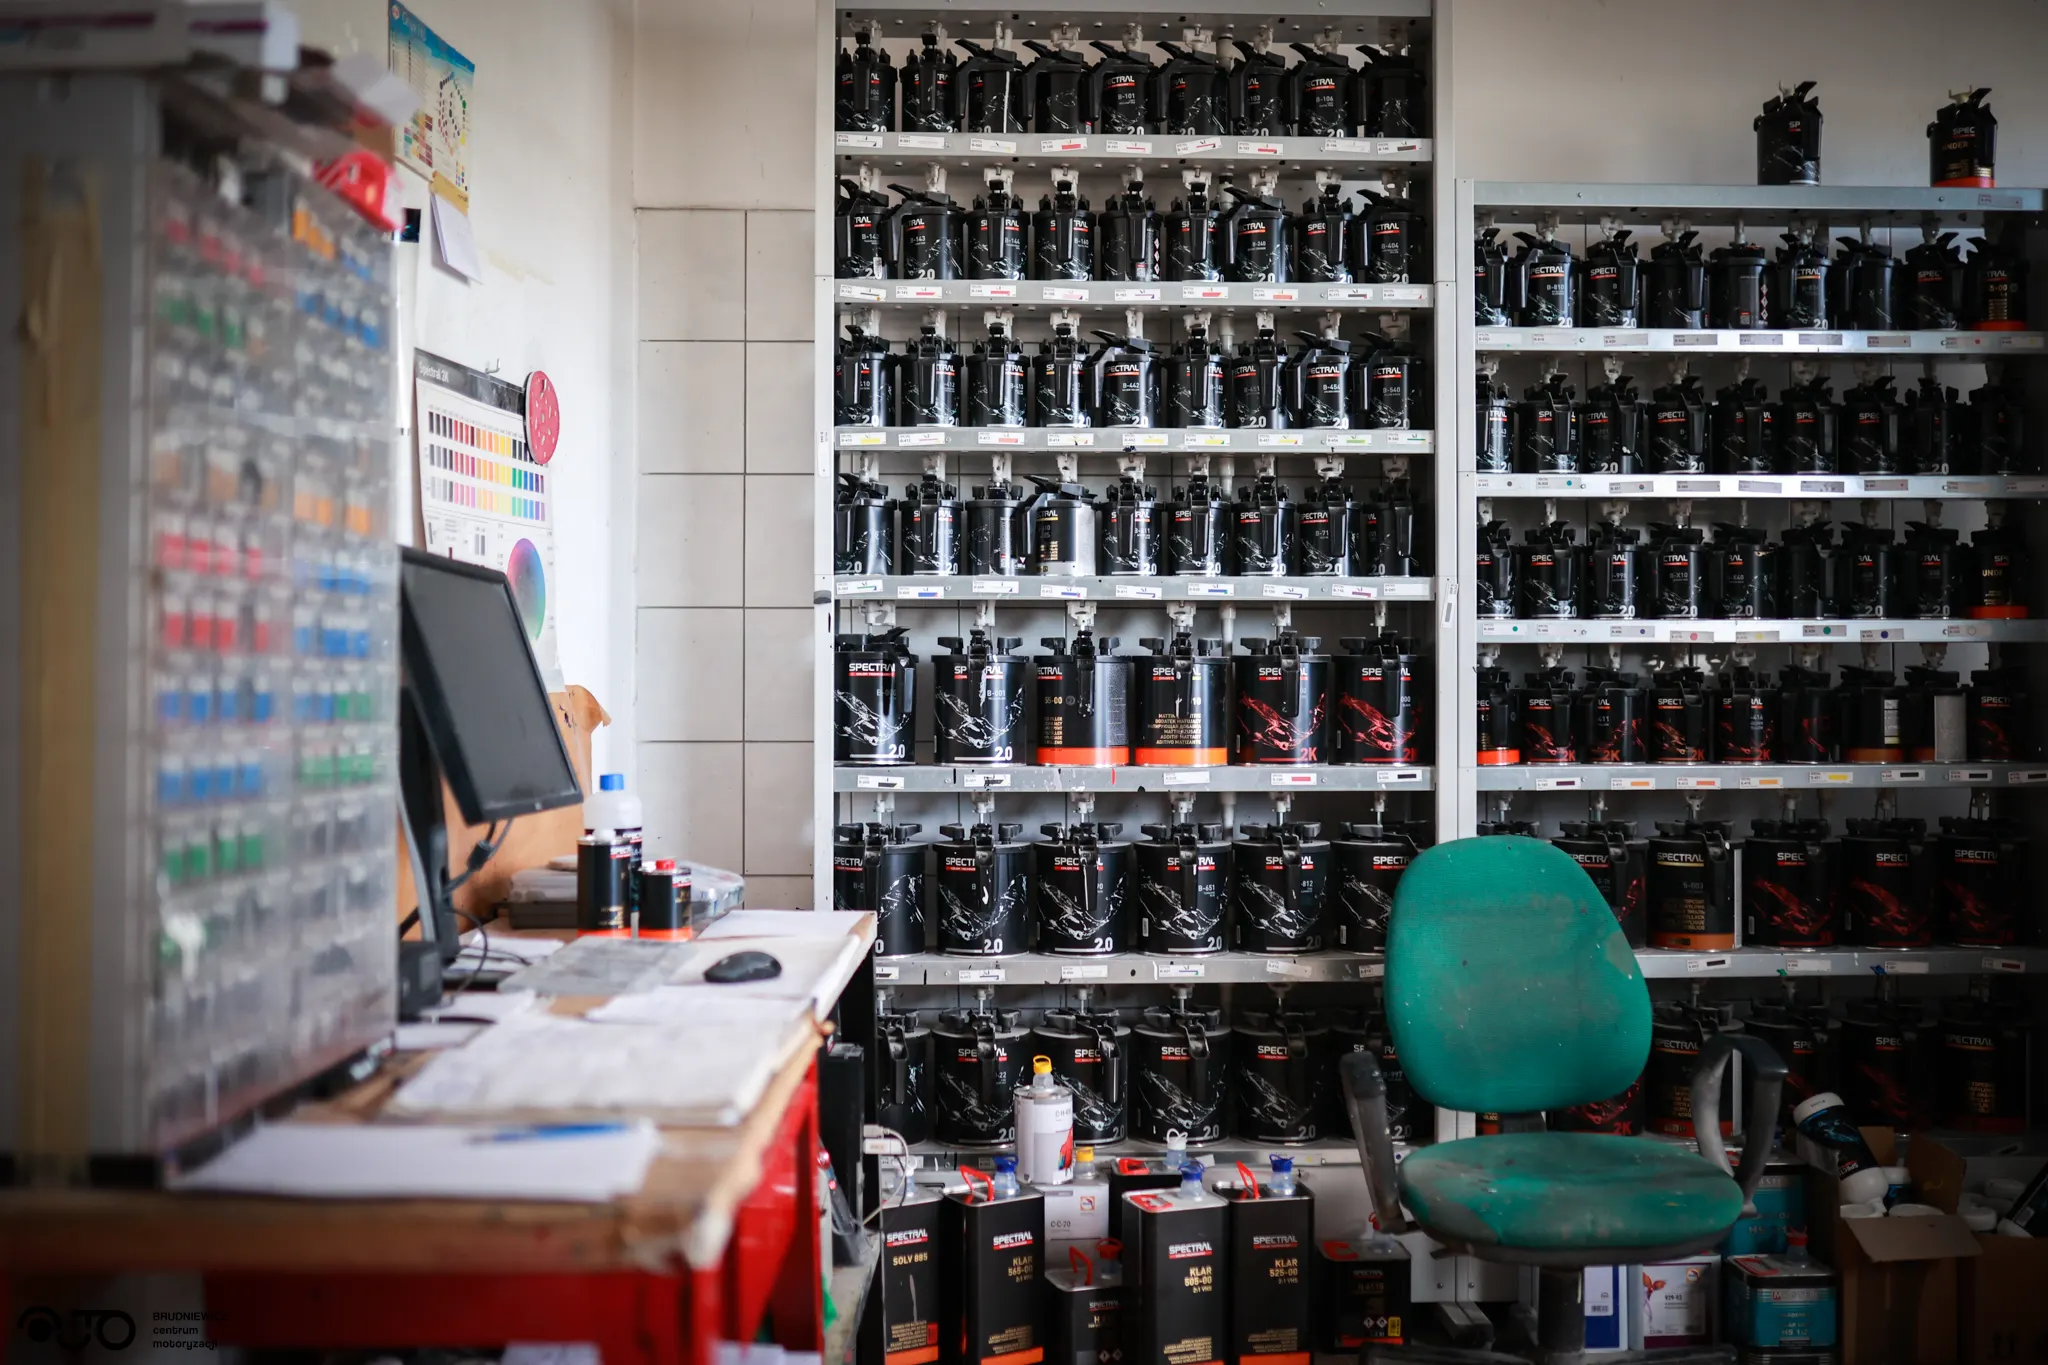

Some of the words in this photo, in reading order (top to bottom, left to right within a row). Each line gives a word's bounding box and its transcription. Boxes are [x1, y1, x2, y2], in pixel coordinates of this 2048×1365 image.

[888, 745, 906, 759] 2.0
[994, 746, 1013, 761] 2.0
[983, 939, 1004, 954] 2.0
[1093, 937, 1114, 952] 2.0
[1203, 1124, 1220, 1139] 2.0
[886, 1228, 929, 1243] SPECTRAL
[992, 1231, 1034, 1246] SPECTRAL
[1252, 1235, 1299, 1246] SPECTRAL
[1168, 1241, 1213, 1255] SPECTRAL
[1012, 1256, 1034, 1267] KLAR
[1274, 1258, 1298, 1269] KLAR
[1189, 1266, 1213, 1277] KLAR
